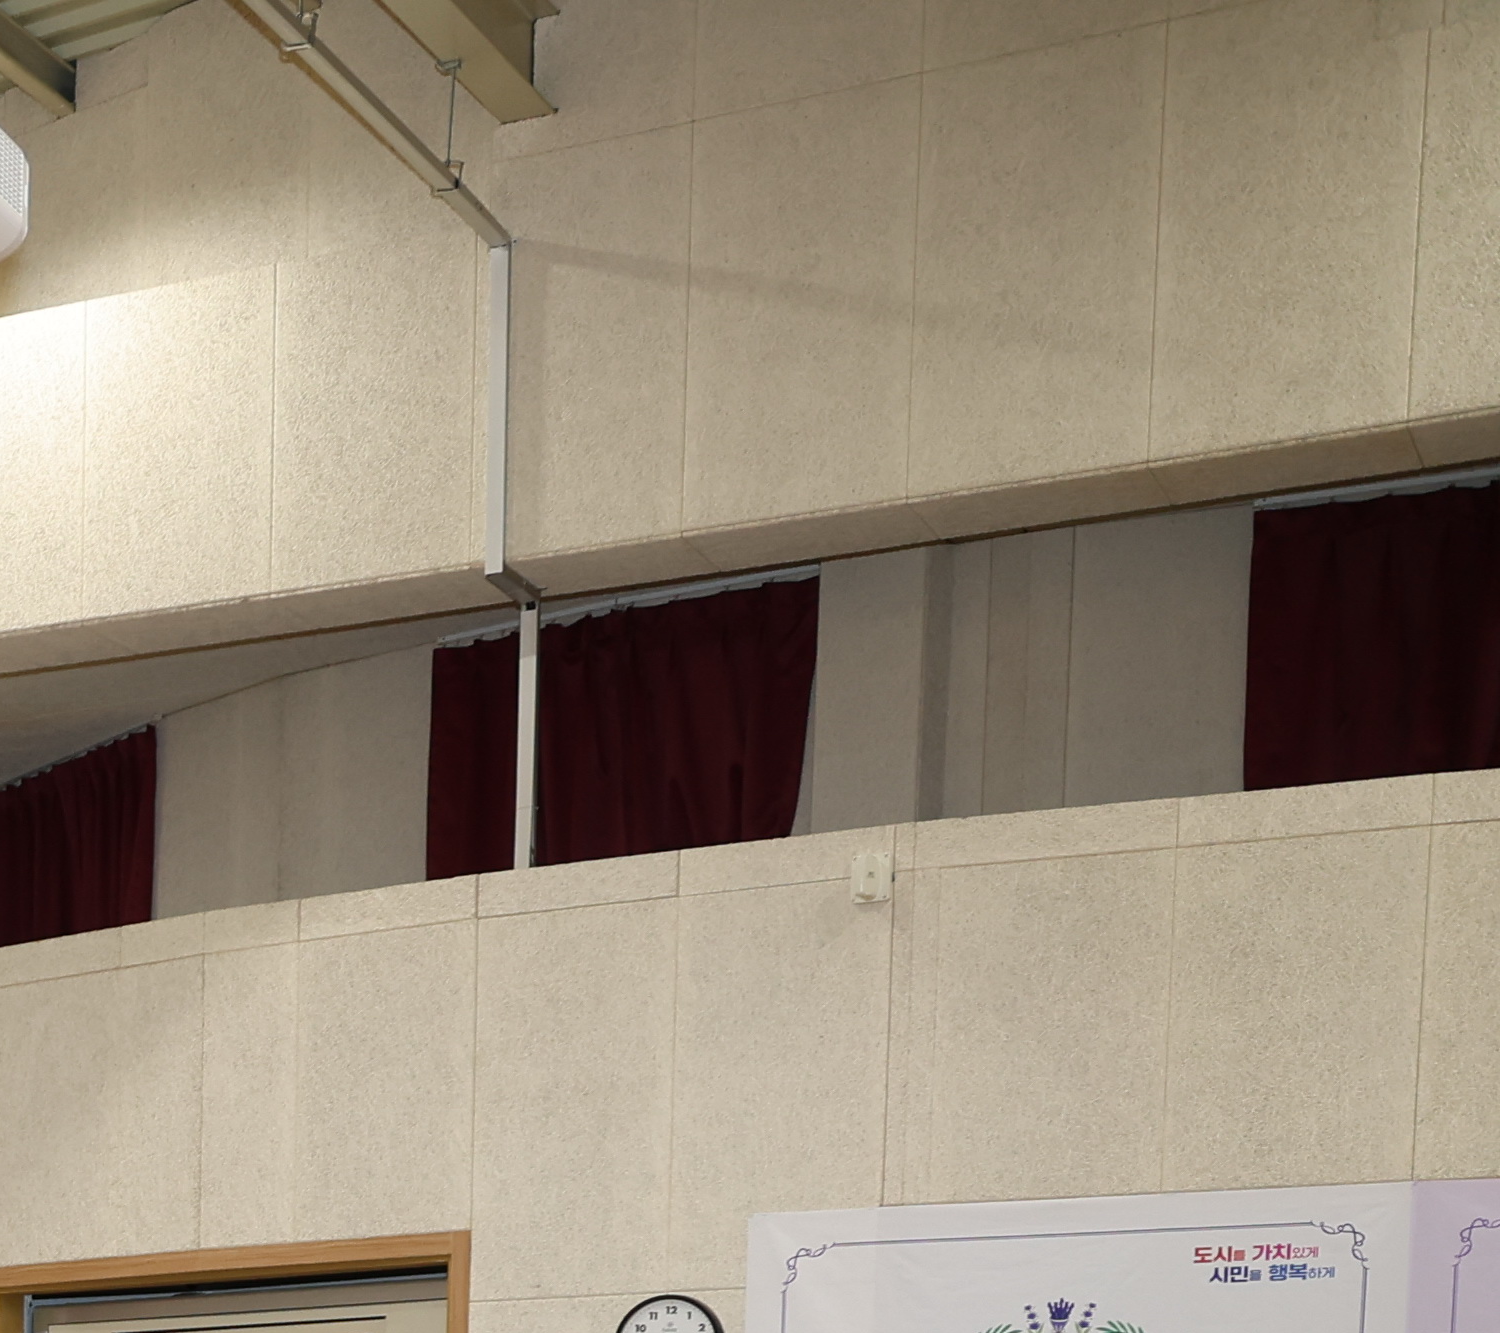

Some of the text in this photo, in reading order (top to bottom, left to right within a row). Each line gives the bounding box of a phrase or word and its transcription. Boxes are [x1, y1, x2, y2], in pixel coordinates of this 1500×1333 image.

[1193, 1243, 1319, 1263] 도시를 가치있게
[1209, 1263, 1335, 1283] 시민을 행복하게
[666, 1306, 678, 1315] 12
[649, 1312, 658, 1320] 11
[687, 1311, 692, 1320] 1
[635, 1324, 647, 1333] 10
[698, 1324, 705, 1332] 2
